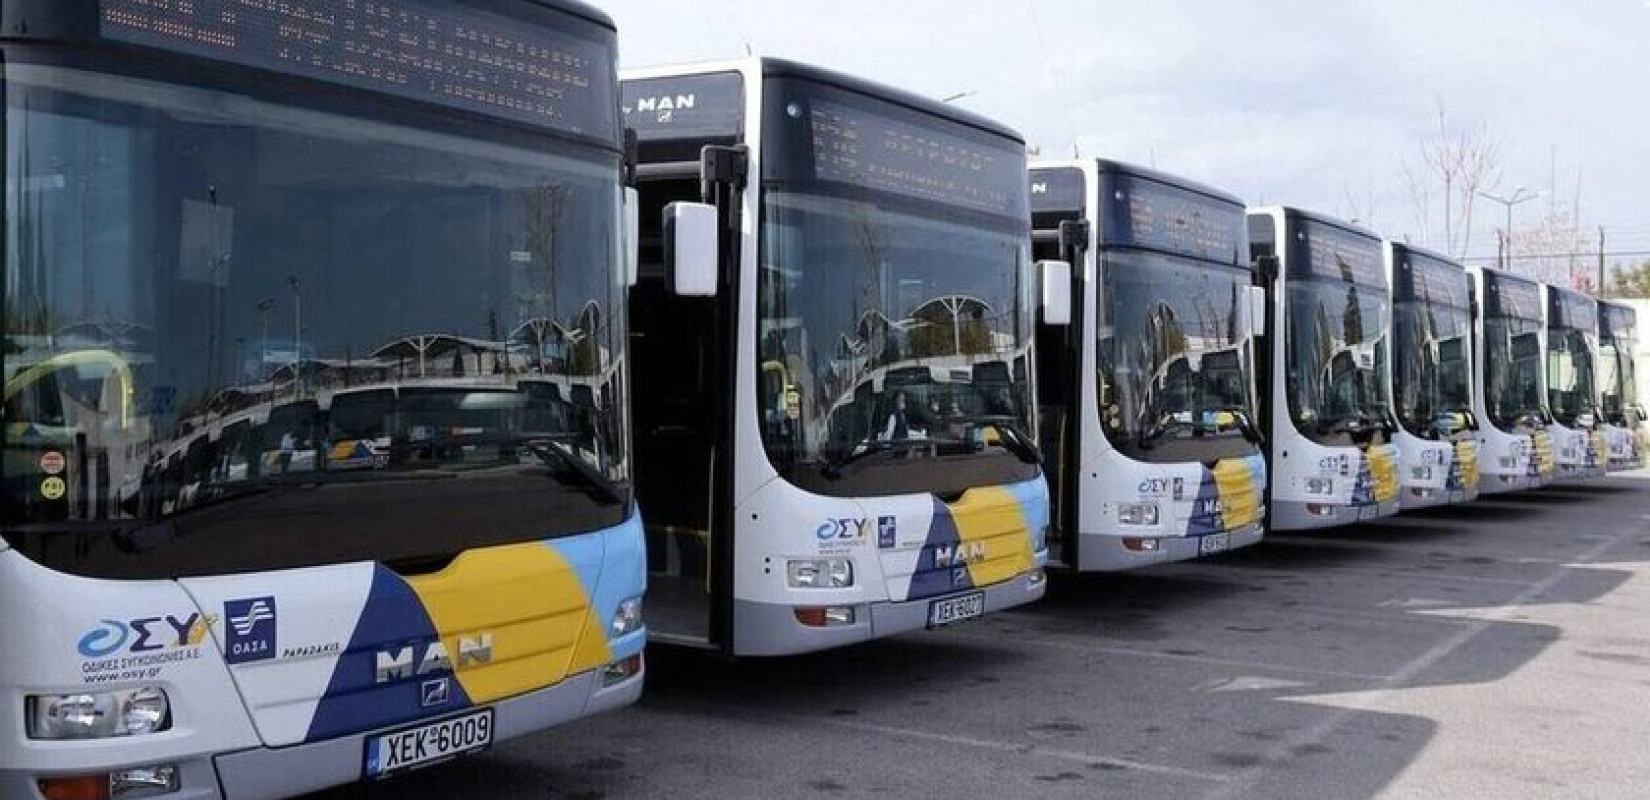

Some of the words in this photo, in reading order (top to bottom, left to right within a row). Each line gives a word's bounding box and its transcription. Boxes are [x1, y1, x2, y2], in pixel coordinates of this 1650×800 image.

[637, 94, 695, 112] MAN
[817, 518, 867, 540] ΟΣΥ
[935, 542, 984, 569] MAN
[77, 612, 200, 658] ΟΣΥ
[233, 640, 268, 655] ΟΑΣΑ
[376, 631, 494, 683] MAN
[83, 667, 162, 683] www.osy.gr
[386, 714, 488, 767] XEK-6009
